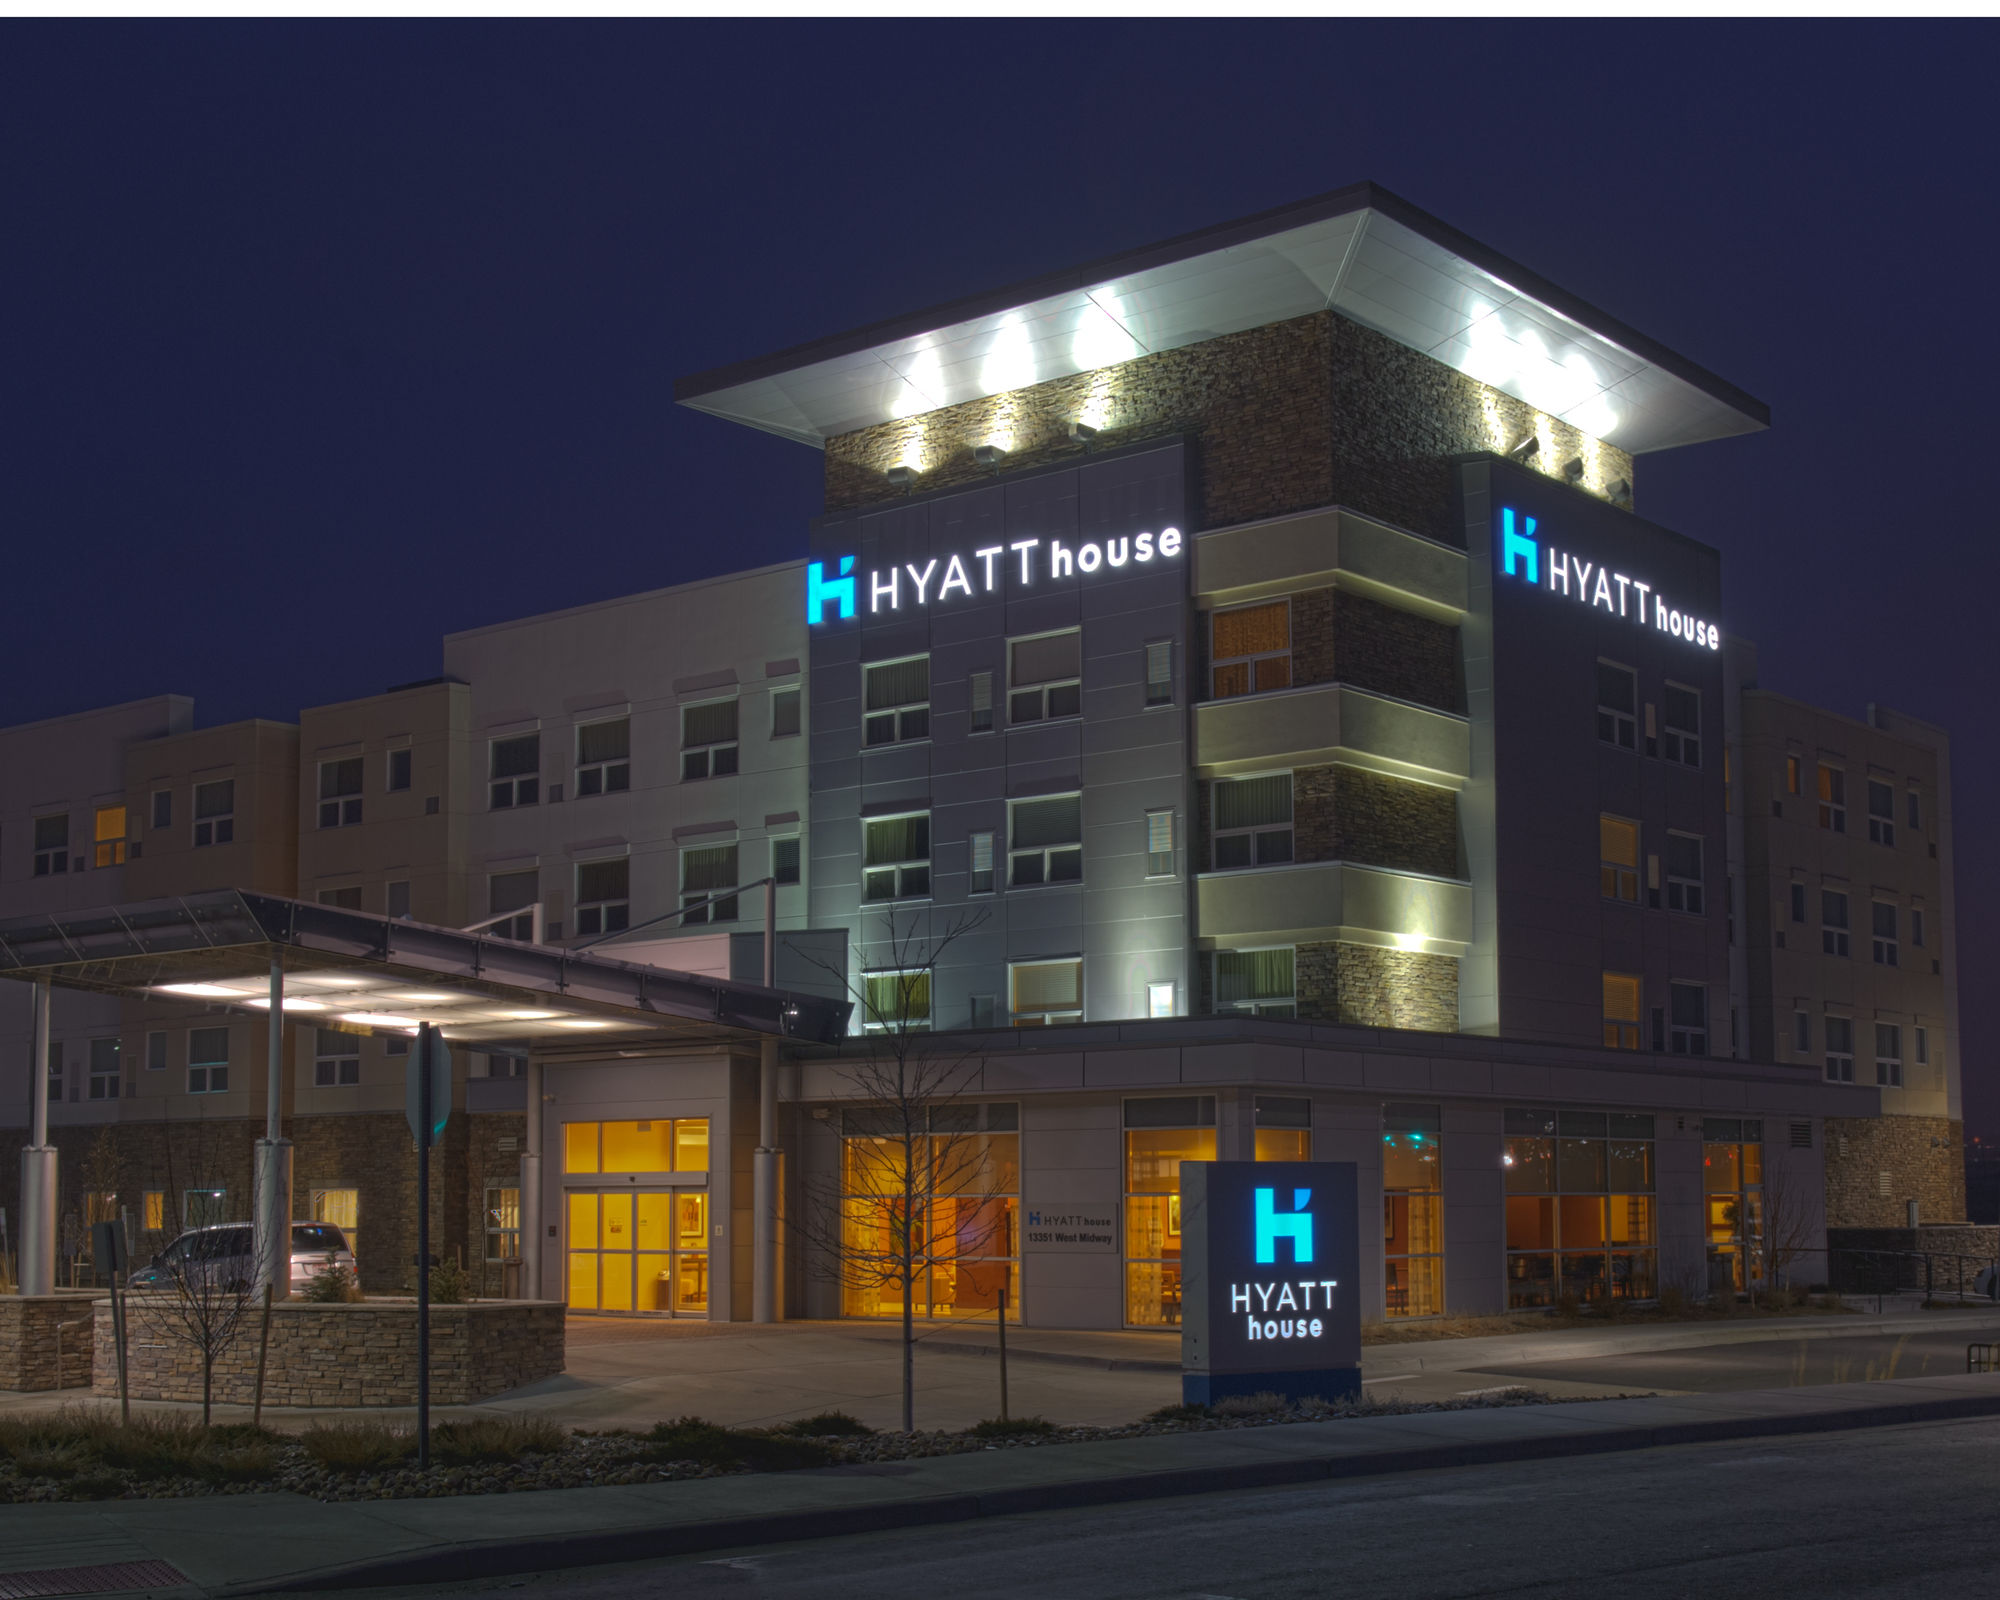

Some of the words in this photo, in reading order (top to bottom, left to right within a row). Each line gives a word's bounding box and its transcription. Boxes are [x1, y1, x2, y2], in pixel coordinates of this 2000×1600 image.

[871, 538, 1039, 613] HYATT
[1051, 527, 1182, 578] house
[1550, 547, 1650, 624] HYATT
[1656, 594, 1719, 651] house
[1044, 1215, 1082, 1226] HYATT
[1083, 1215, 1112, 1226] house
[1028, 1232, 1053, 1242] 13351
[1054, 1232, 1078, 1242] West
[1079, 1232, 1112, 1246] Midway
[1231, 1280, 1338, 1314] HYATT
[1247, 1314, 1324, 1341] house
